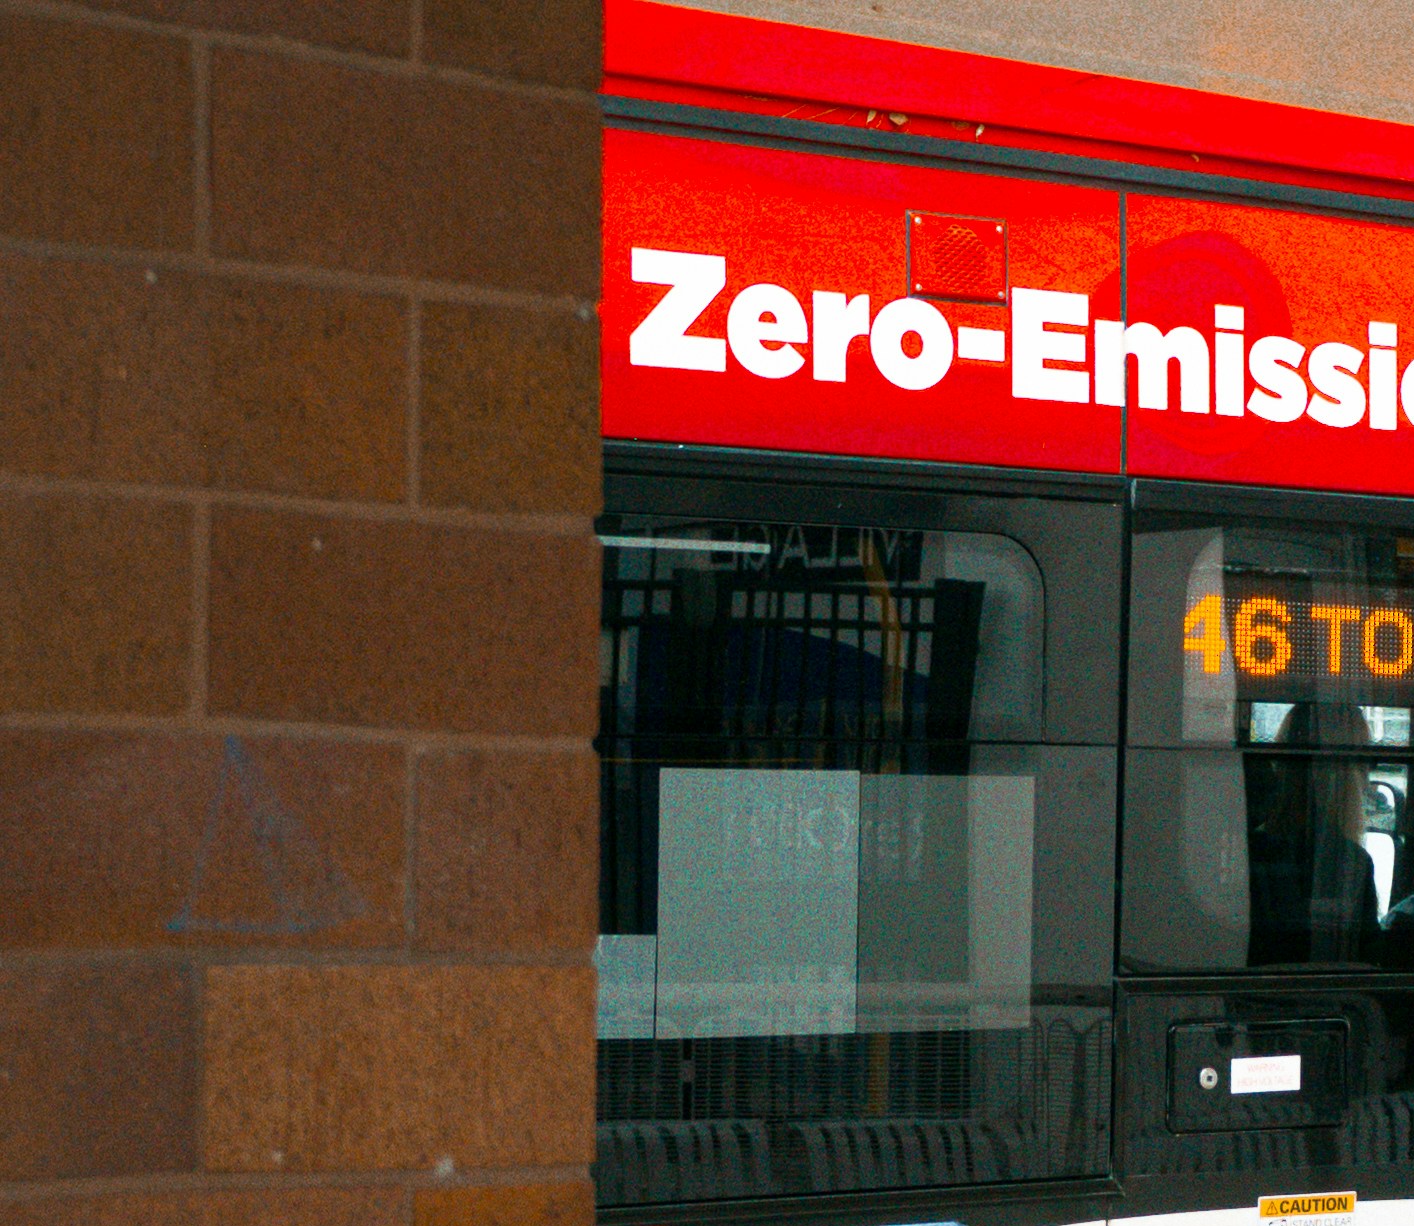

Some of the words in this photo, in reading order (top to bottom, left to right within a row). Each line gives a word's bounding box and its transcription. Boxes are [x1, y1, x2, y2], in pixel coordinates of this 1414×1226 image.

[1183, 595, 1293, 676] 46
[1310, 606, 1414, 676] TO
[1279, 1197, 1348, 1213] CAUTION
